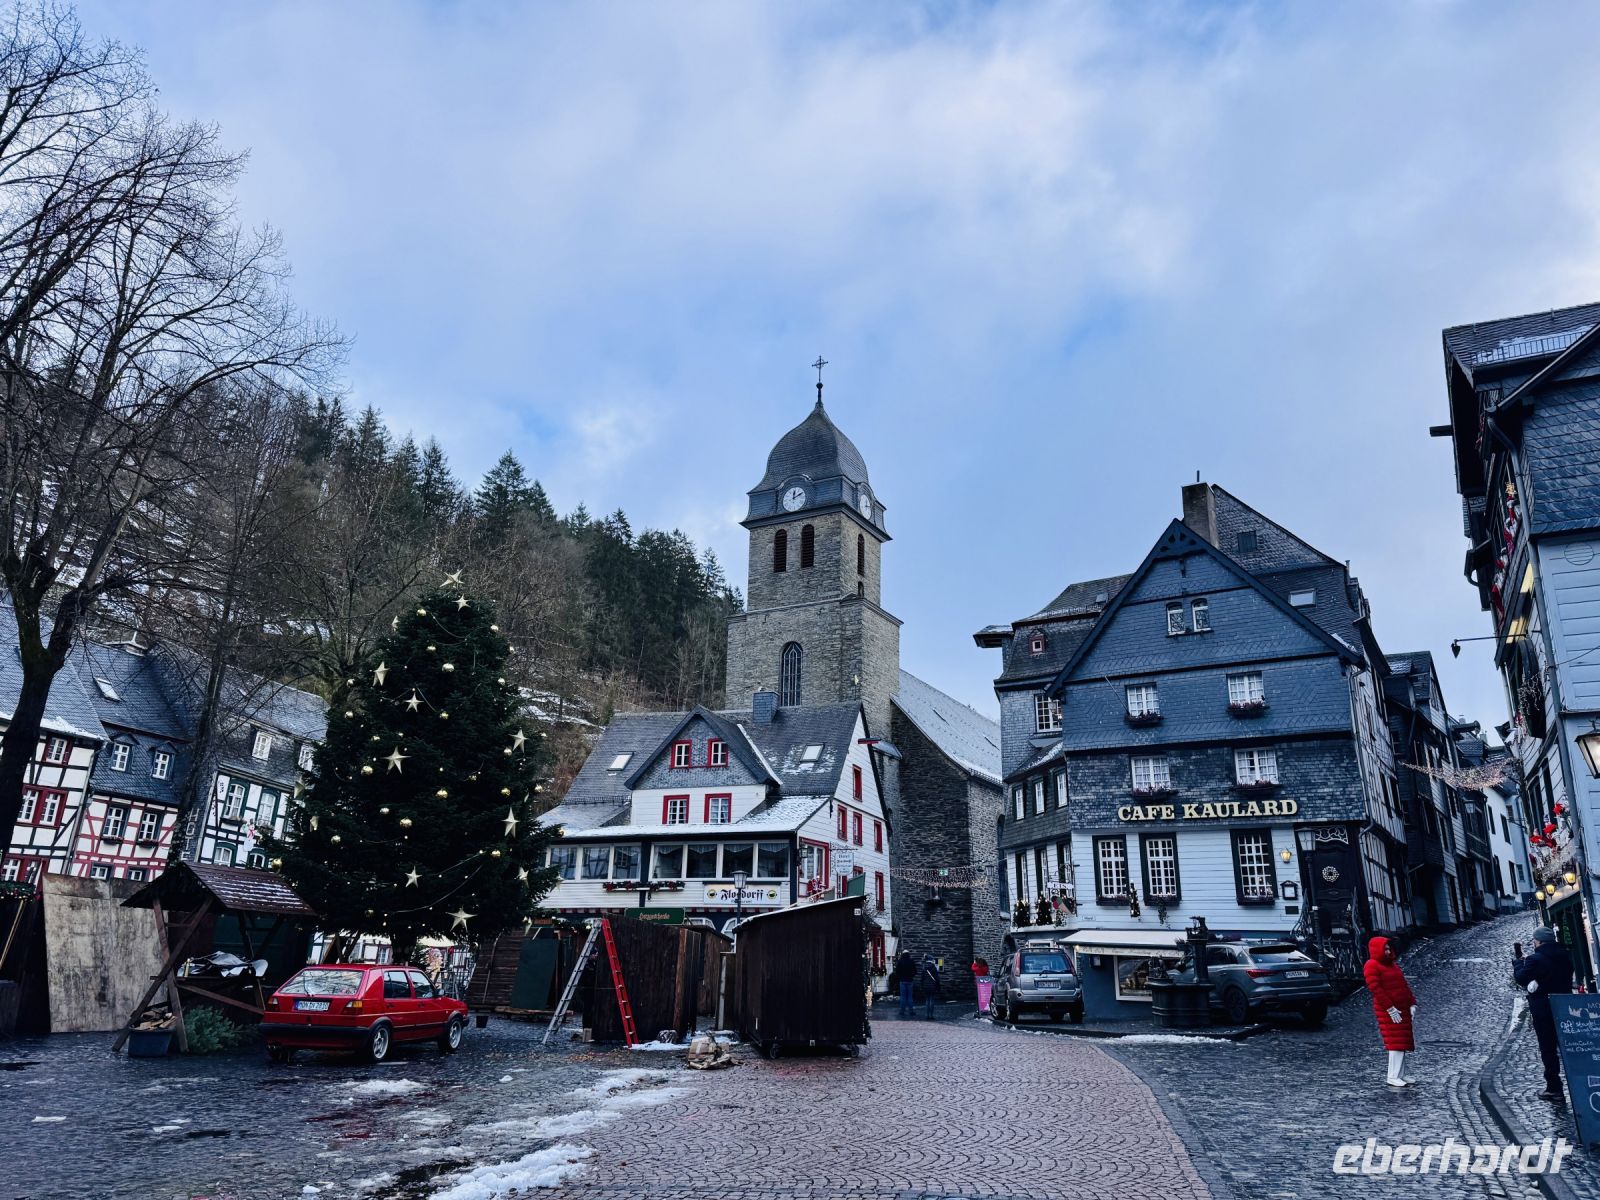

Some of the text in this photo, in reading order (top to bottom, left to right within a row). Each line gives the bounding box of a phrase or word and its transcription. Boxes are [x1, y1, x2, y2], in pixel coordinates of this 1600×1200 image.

[1117, 799, 1298, 821] CAFE KAULARD
[180, 807, 200, 861] HOTE
[720, 888, 764, 901] Flodorff
